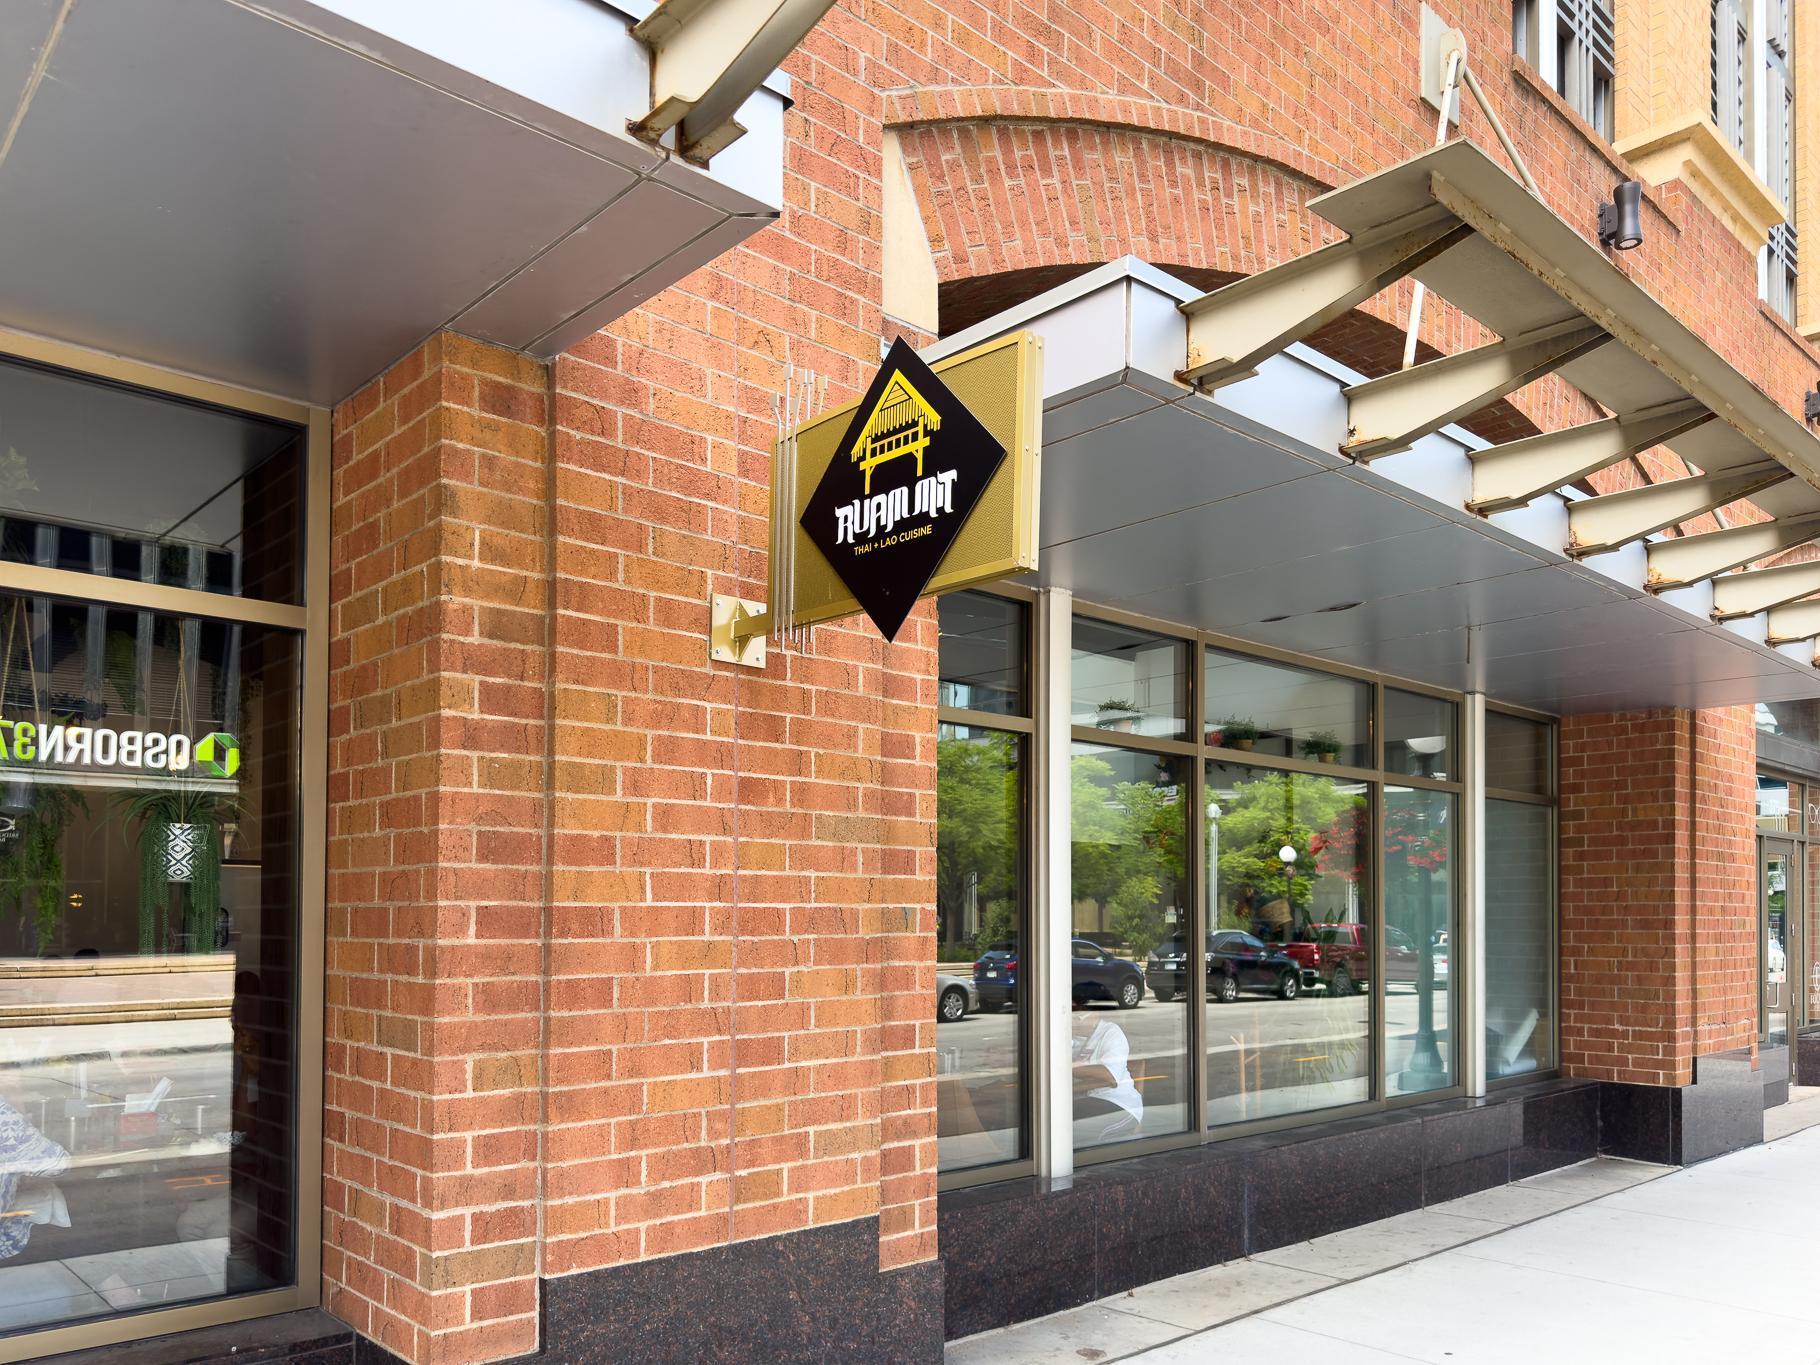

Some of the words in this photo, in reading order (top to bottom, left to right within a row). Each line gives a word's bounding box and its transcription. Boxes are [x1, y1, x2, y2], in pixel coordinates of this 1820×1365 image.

[835, 486, 910, 544] RUAM
[853, 544, 872, 556] THAI
[880, 535, 898, 549] LAO
[899, 525, 932, 541] CUISINE
